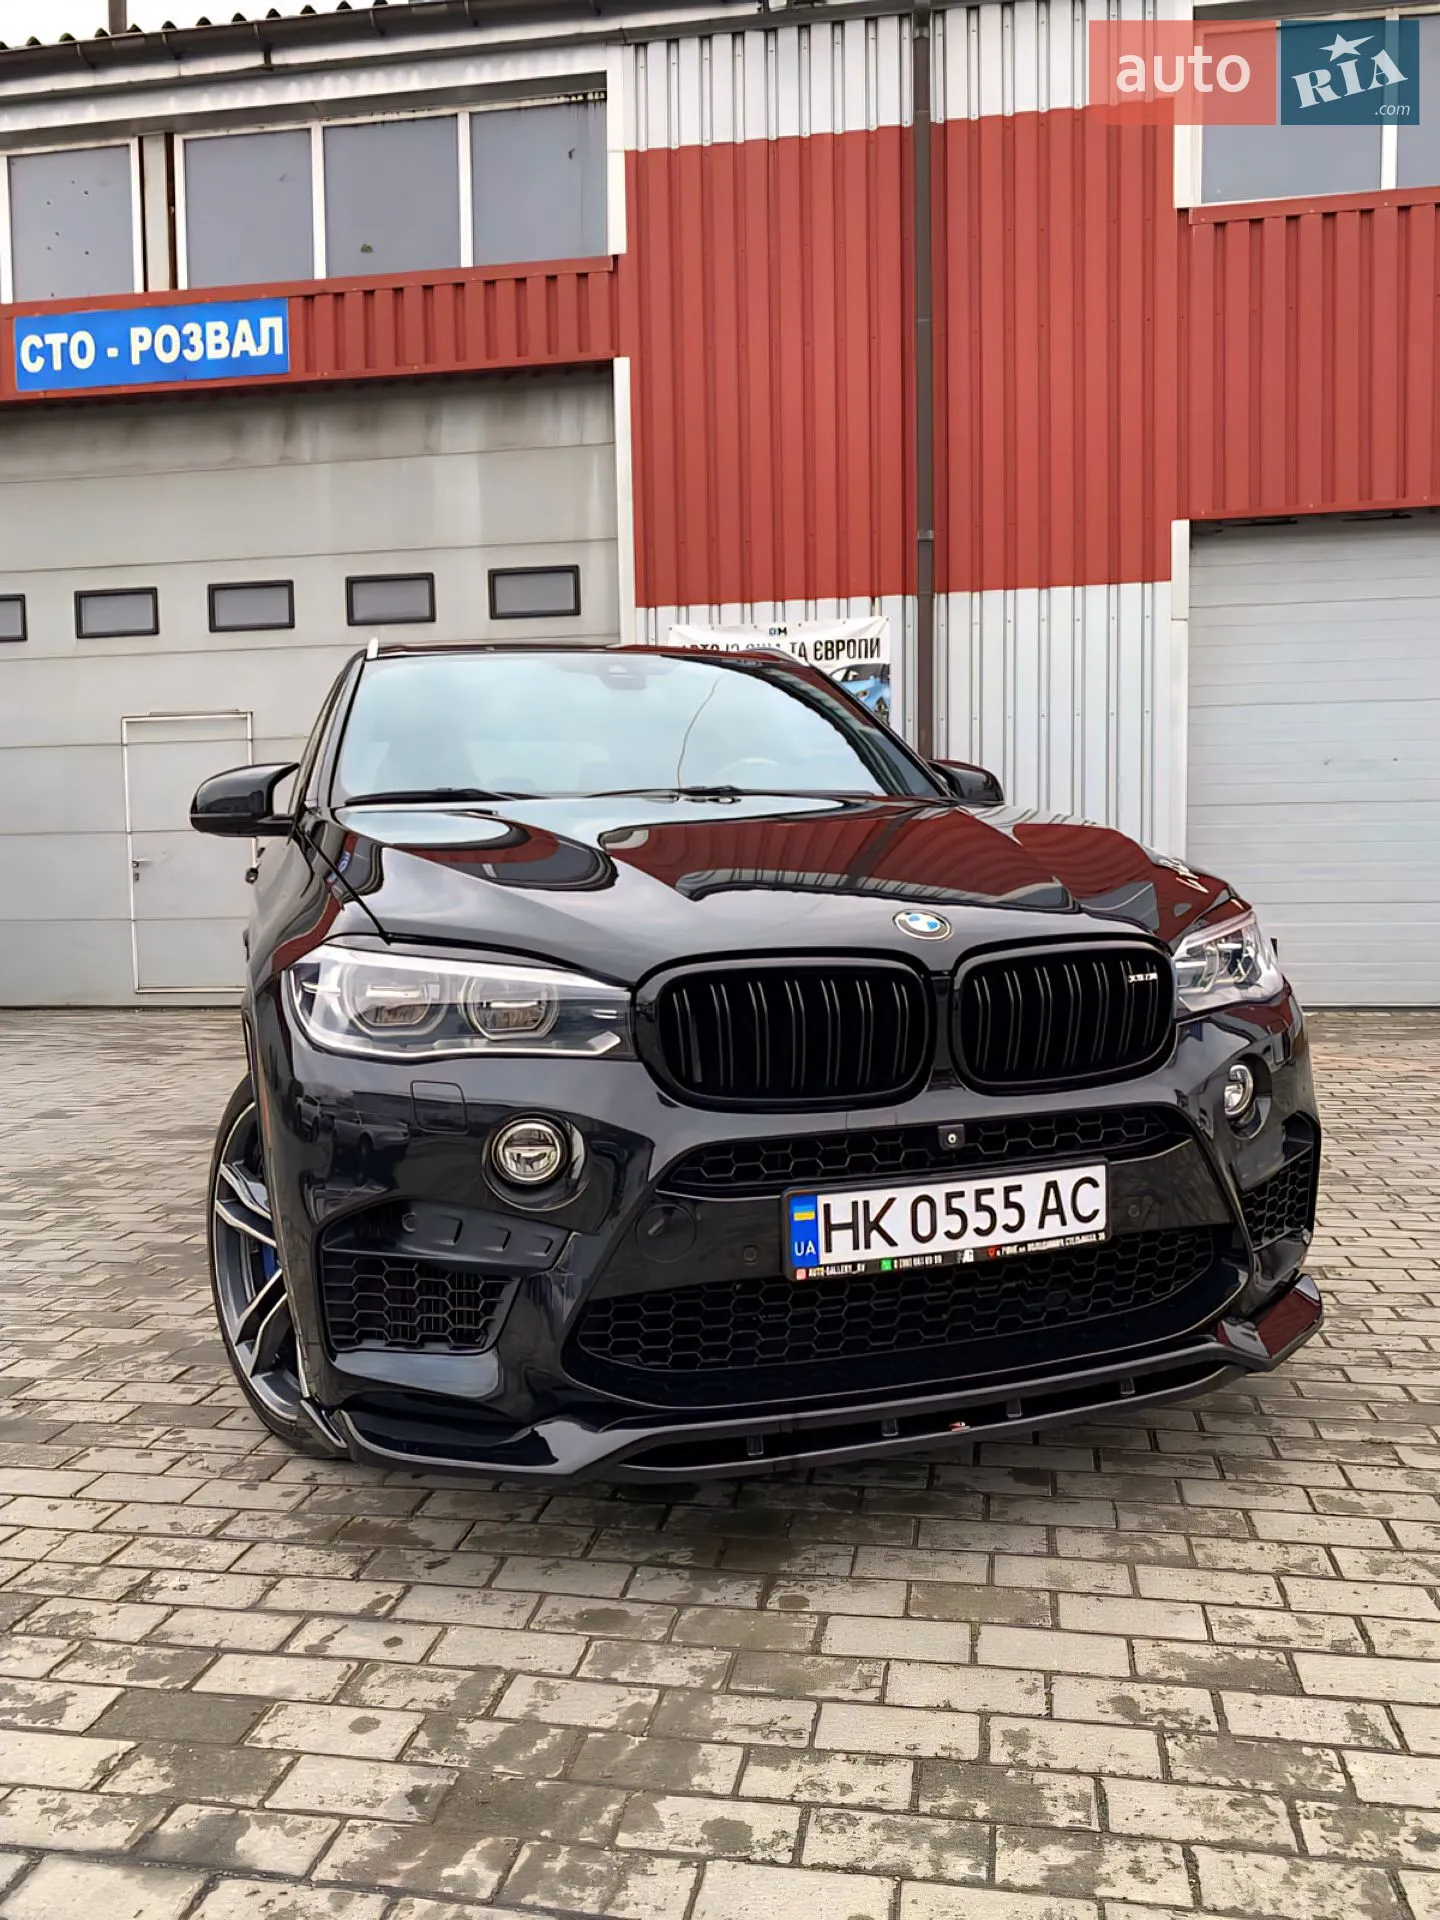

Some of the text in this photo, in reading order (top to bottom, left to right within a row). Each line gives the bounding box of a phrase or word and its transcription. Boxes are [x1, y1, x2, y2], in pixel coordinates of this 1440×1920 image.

[20, 330, 96, 373] СТО
[130, 316, 284, 366] РОЗВАЛ
[814, 637, 880, 661] ЄВРОПИ
[823, 1197, 898, 1253] HK
[910, 1184, 1025, 1244] 0555
[1038, 1176, 1100, 1230] AC
[794, 1240, 816, 1256] UA
